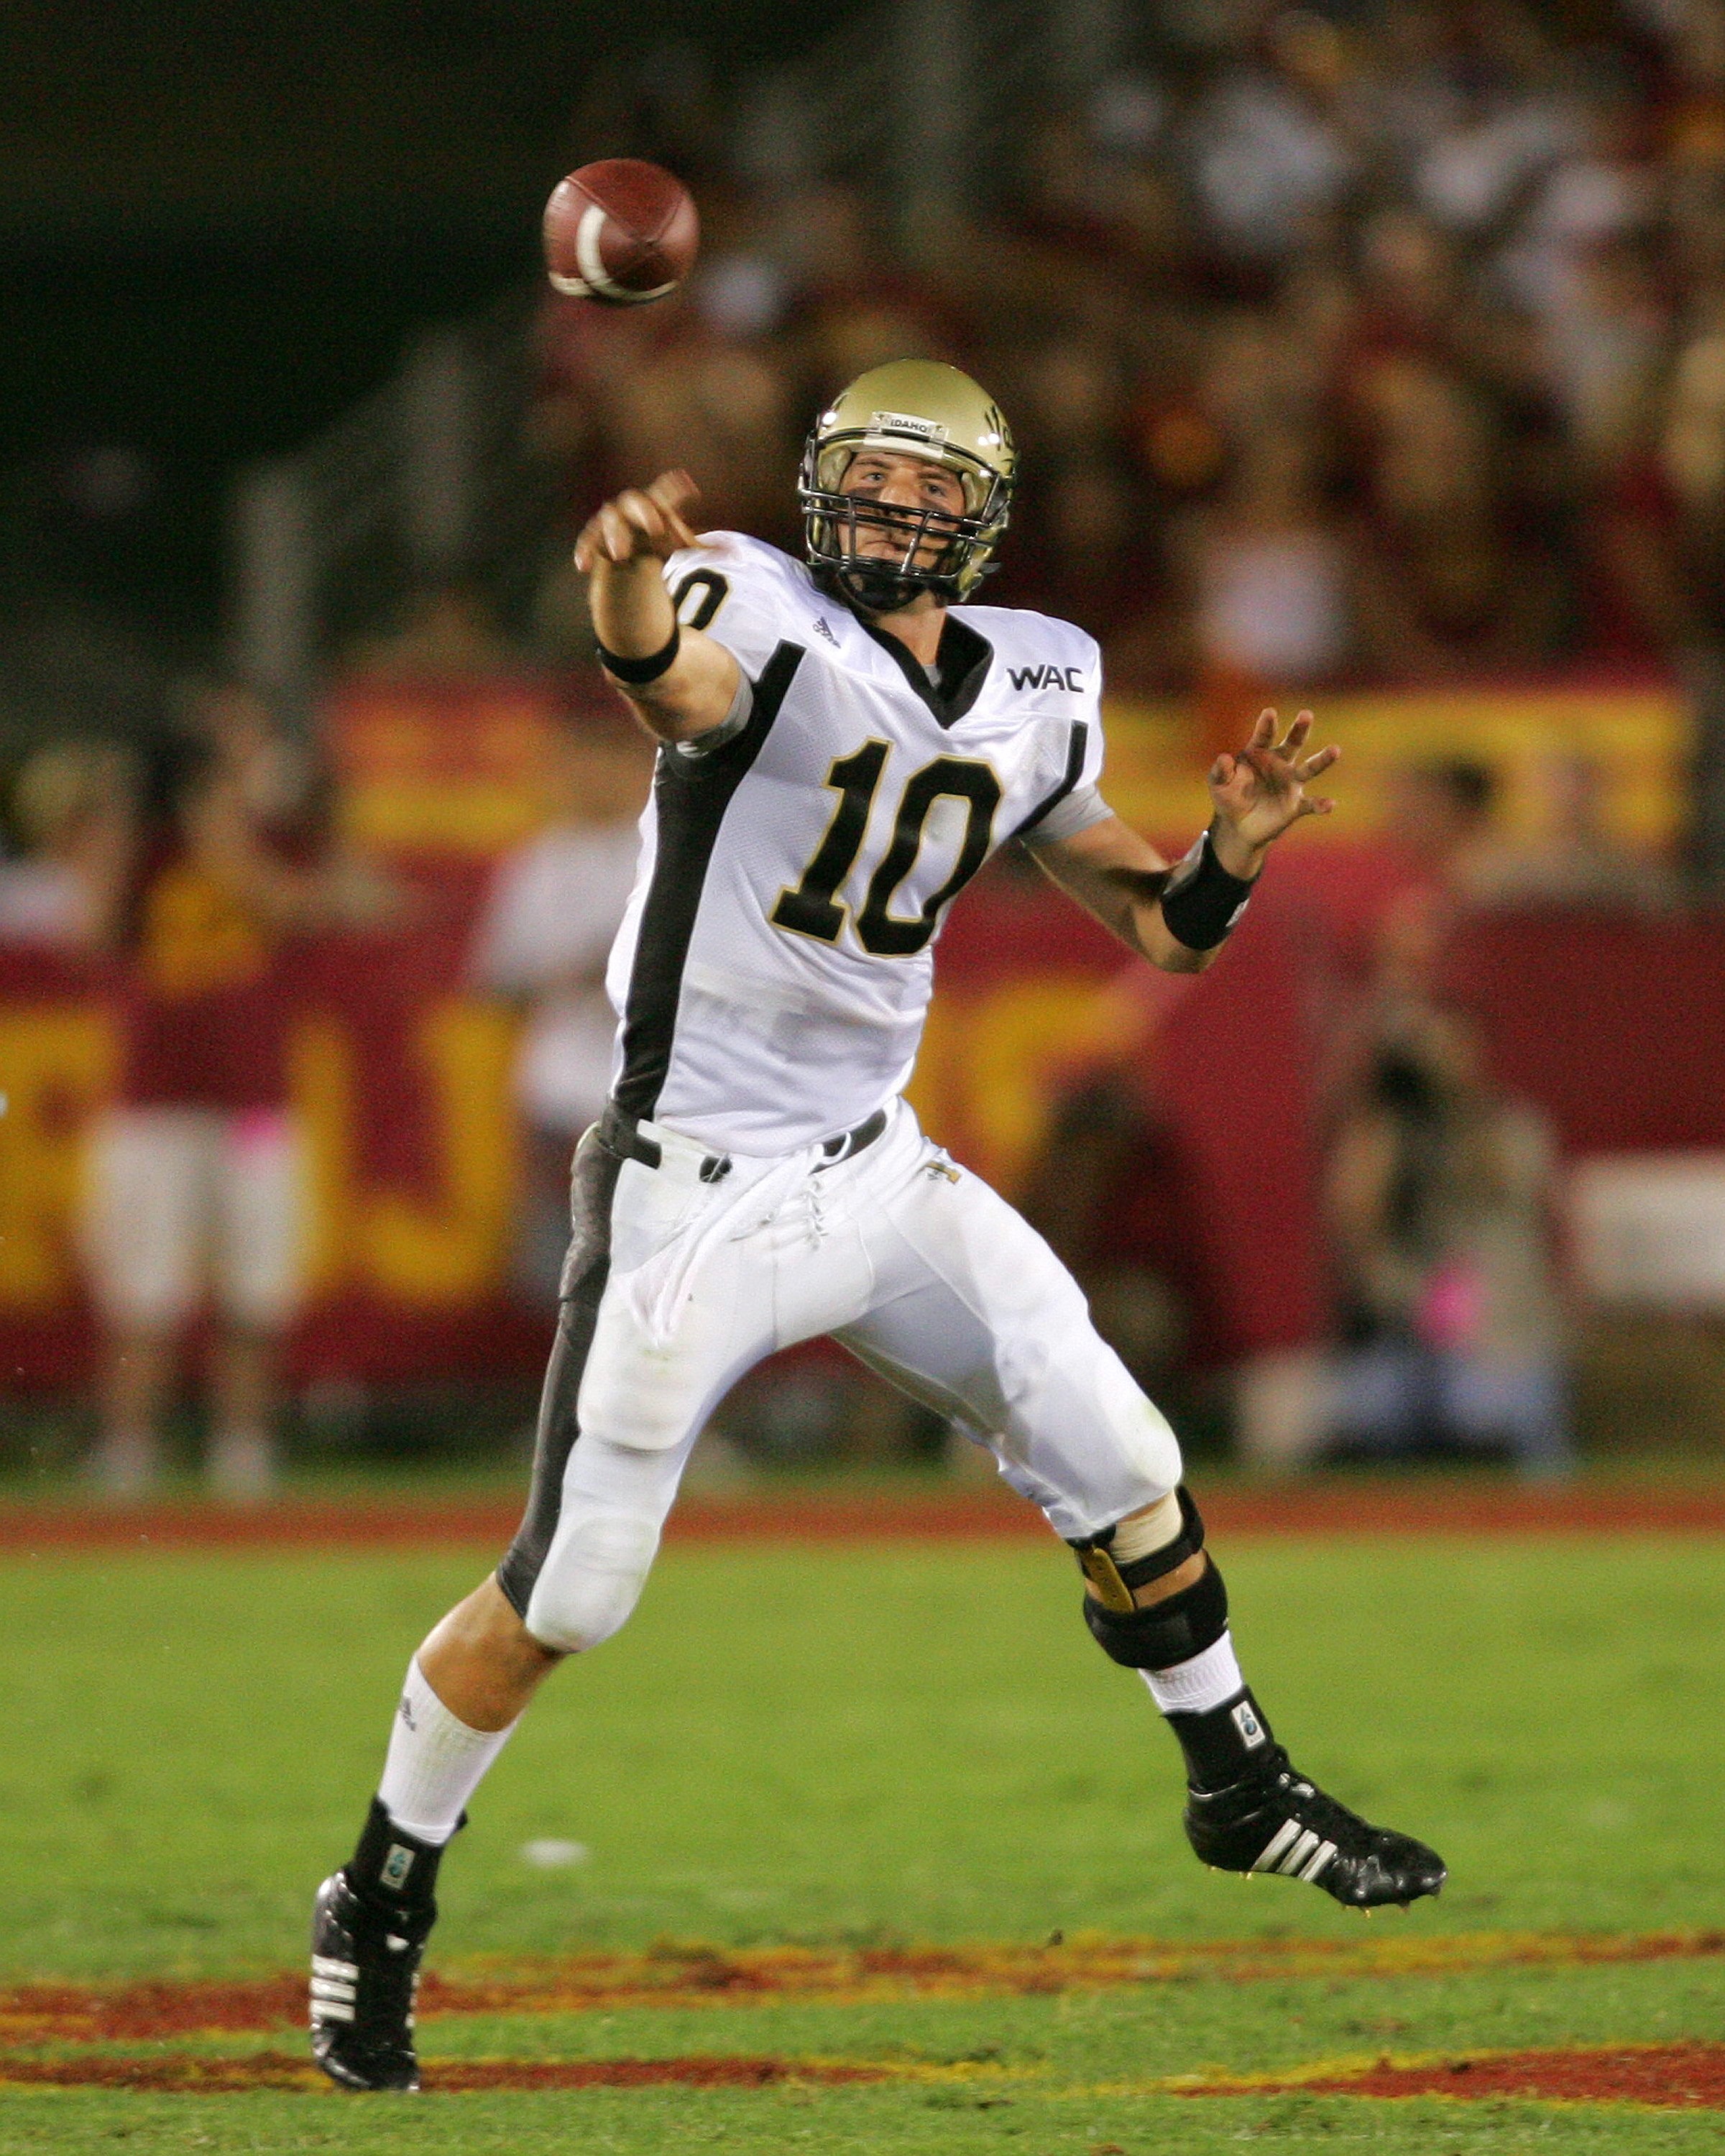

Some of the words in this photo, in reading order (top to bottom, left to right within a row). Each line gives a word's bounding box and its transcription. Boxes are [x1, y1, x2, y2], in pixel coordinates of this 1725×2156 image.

[891, 419, 927, 432] IDAHO
[1006, 664, 1085, 693] WAC
[770, 737, 1003, 957] 10
